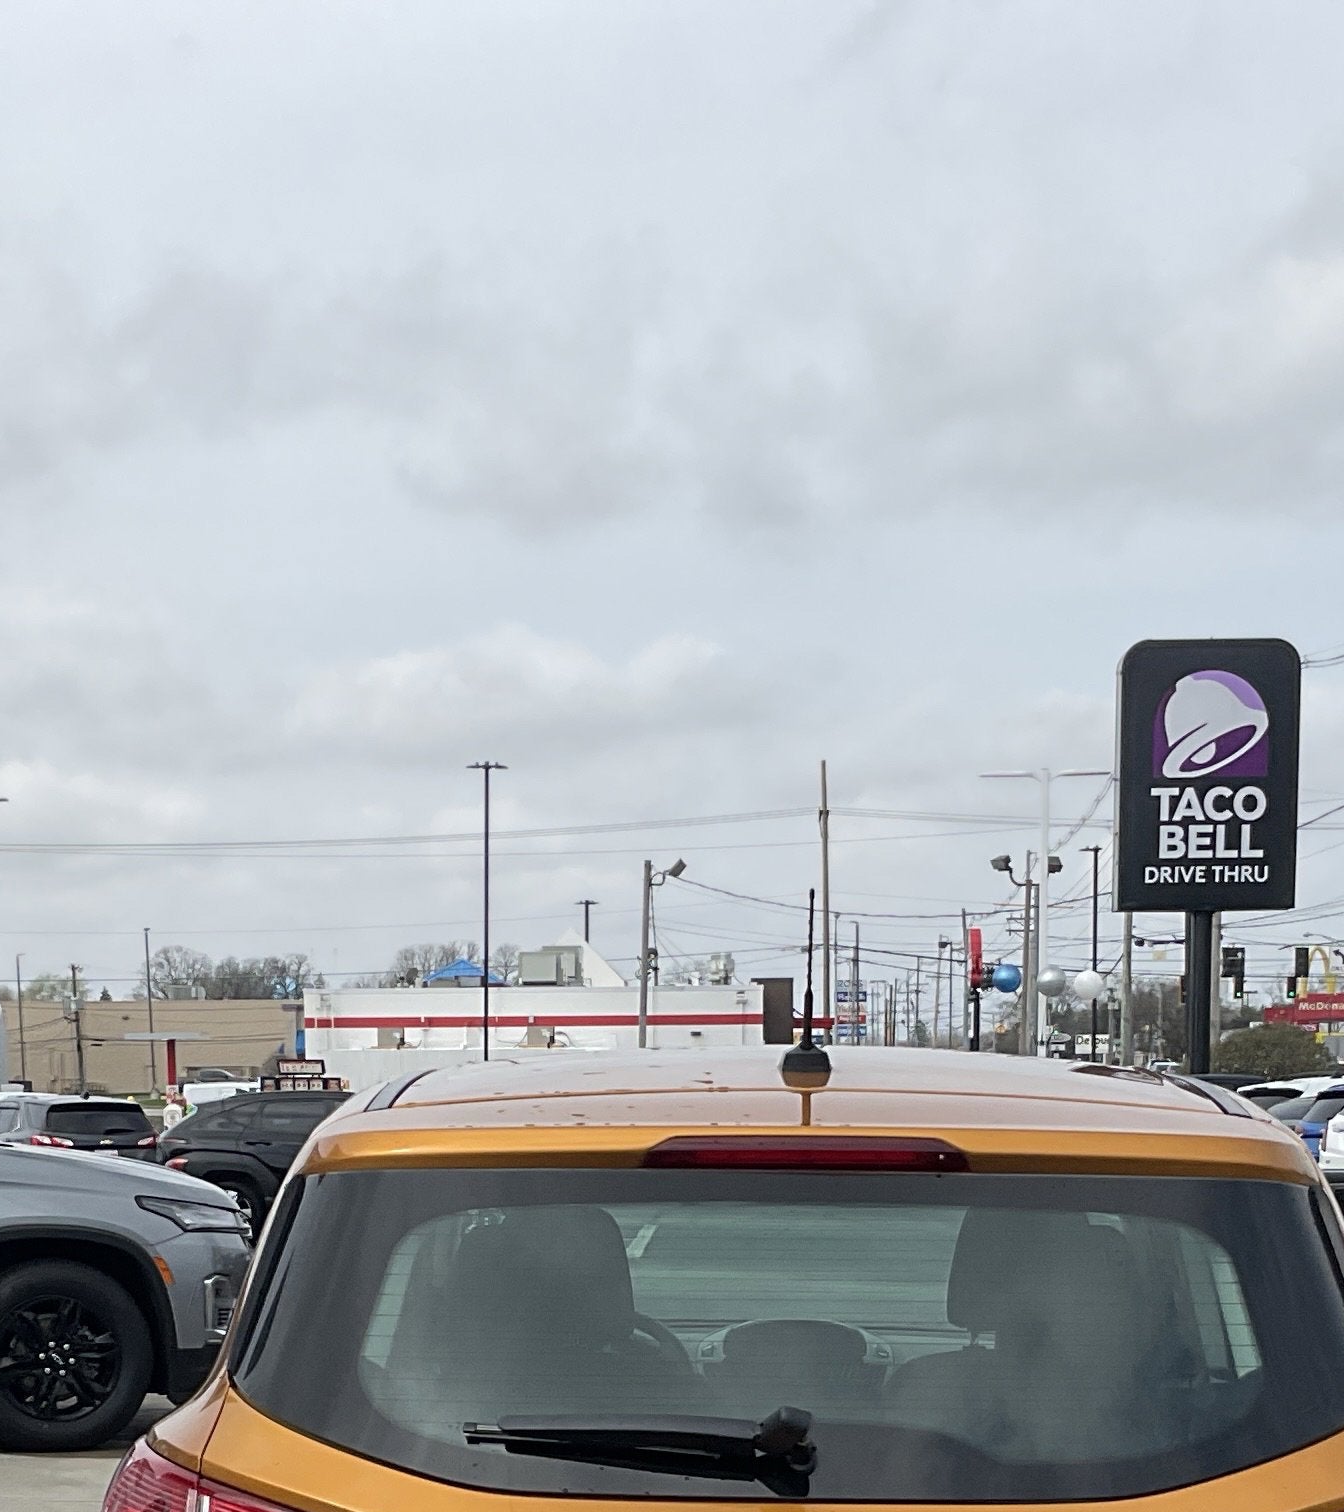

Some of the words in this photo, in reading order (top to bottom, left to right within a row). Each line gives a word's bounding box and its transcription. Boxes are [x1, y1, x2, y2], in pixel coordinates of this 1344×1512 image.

[1150, 786, 1267, 821] TACO
[1158, 824, 1264, 859] BELL
[1144, 866, 1207, 884] DRIVE
[1211, 865, 1269, 883] THRU
